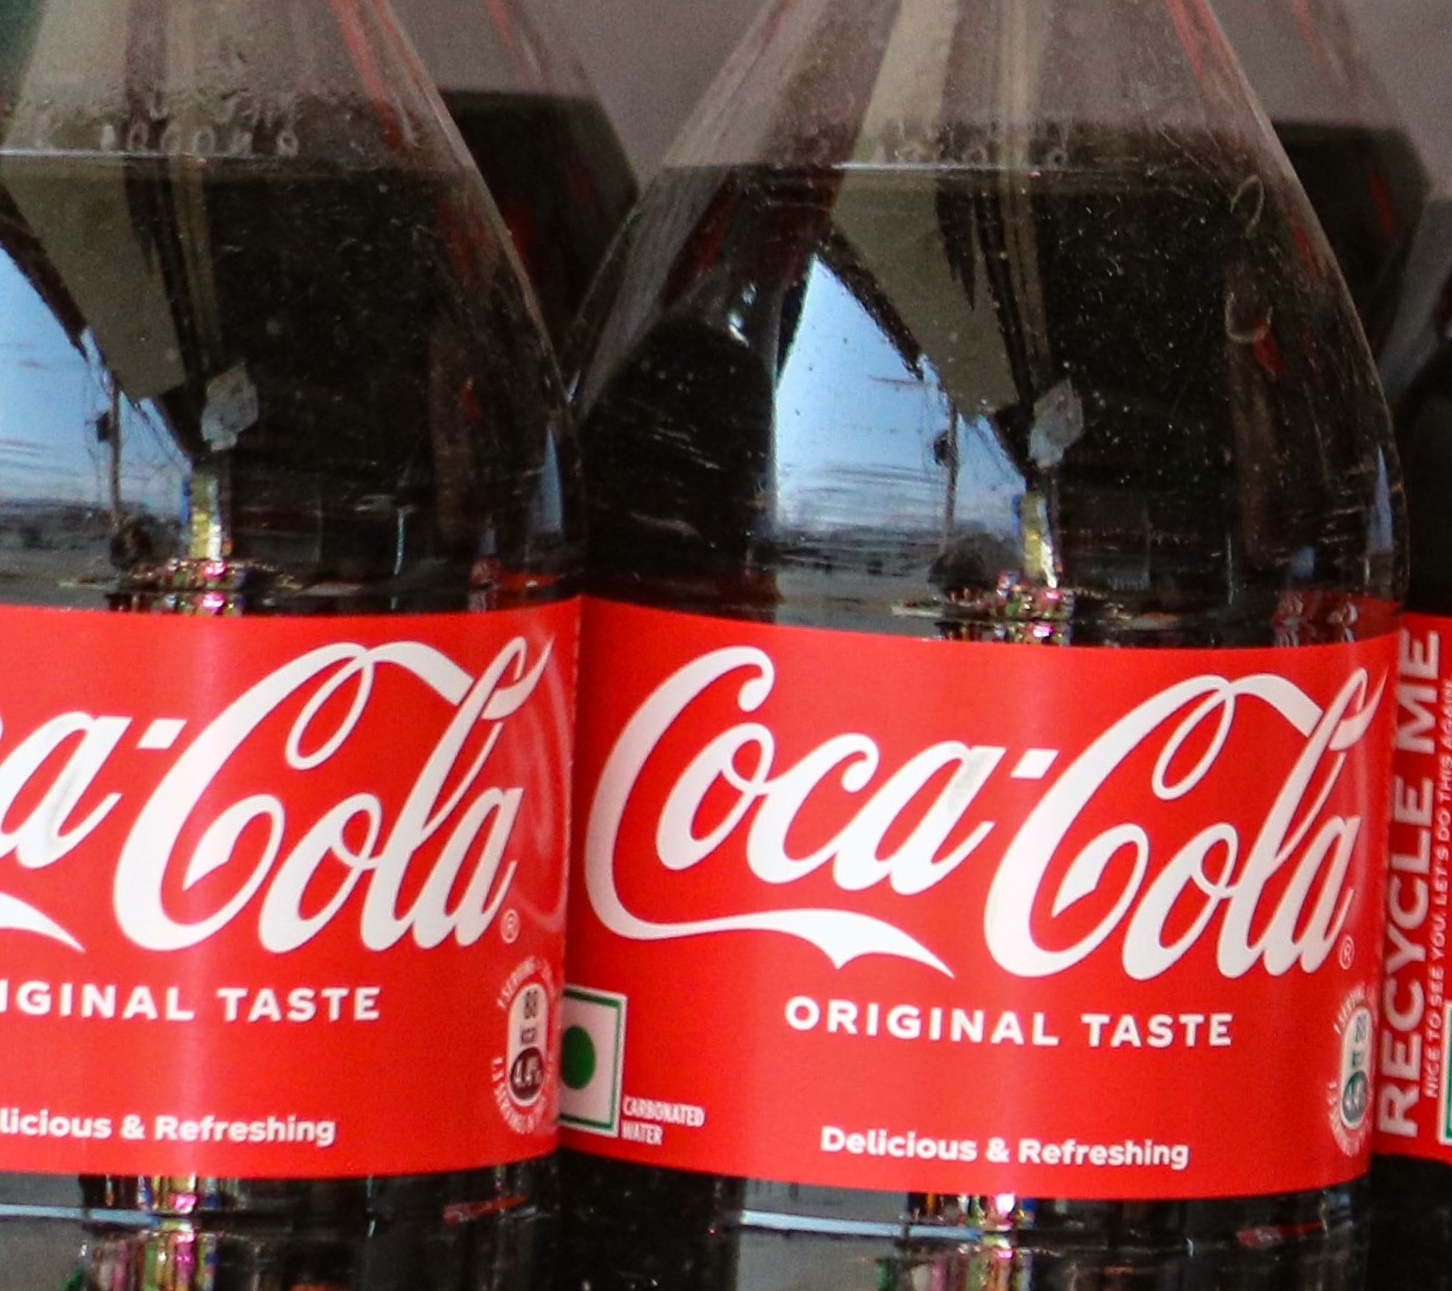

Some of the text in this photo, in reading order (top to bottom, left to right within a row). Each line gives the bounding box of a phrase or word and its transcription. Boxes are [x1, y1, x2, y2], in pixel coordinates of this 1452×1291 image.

[0, 634, 555, 954] a-Cola
[587, 646, 1387, 980] Coca-Cola
[1436, 809, 1451, 841] DO
[1377, 627, 1440, 1137] RECYCLE ME
[0, 979, 381, 1022] IGINAL TASTE
[1428, 965, 1444, 1006] SEE
[784, 996, 1234, 1048] ORIGINAL TASTE
[1426, 1014, 1442, 1042] TO
[1424, 1047, 1441, 1098] NICE
[0, 1107, 336, 1147] licious & Refreshing
[620, 1120, 663, 1146] WATER
[622, 1095, 705, 1128] CARBONATED
[820, 1125, 1190, 1170] Delicious & Refreshing
